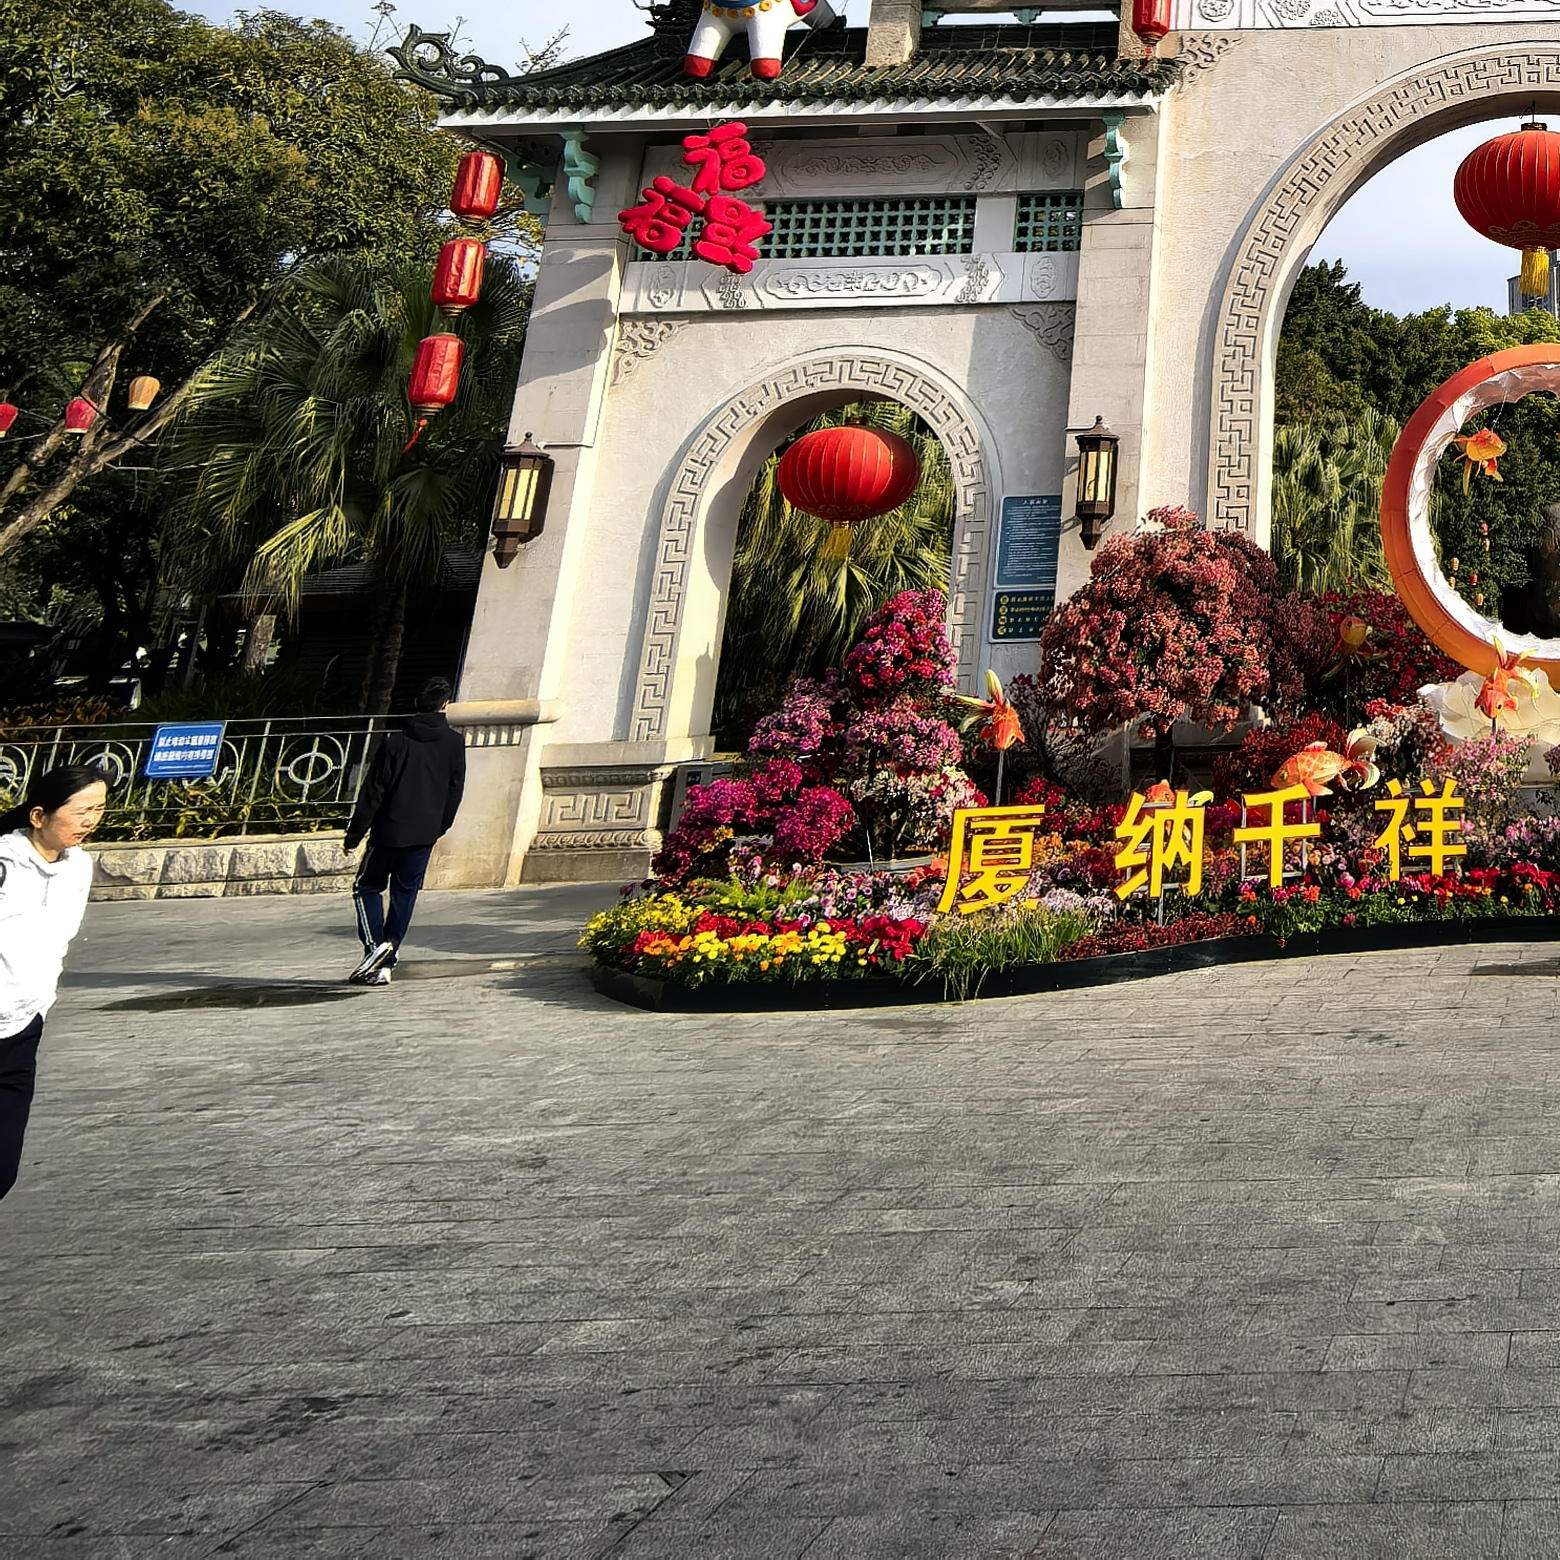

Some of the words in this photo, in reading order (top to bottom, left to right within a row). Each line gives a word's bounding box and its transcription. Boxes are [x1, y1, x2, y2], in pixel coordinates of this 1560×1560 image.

[682, 121, 767, 196] 福
[937, 776, 1469, 915] 厦纳千祥
